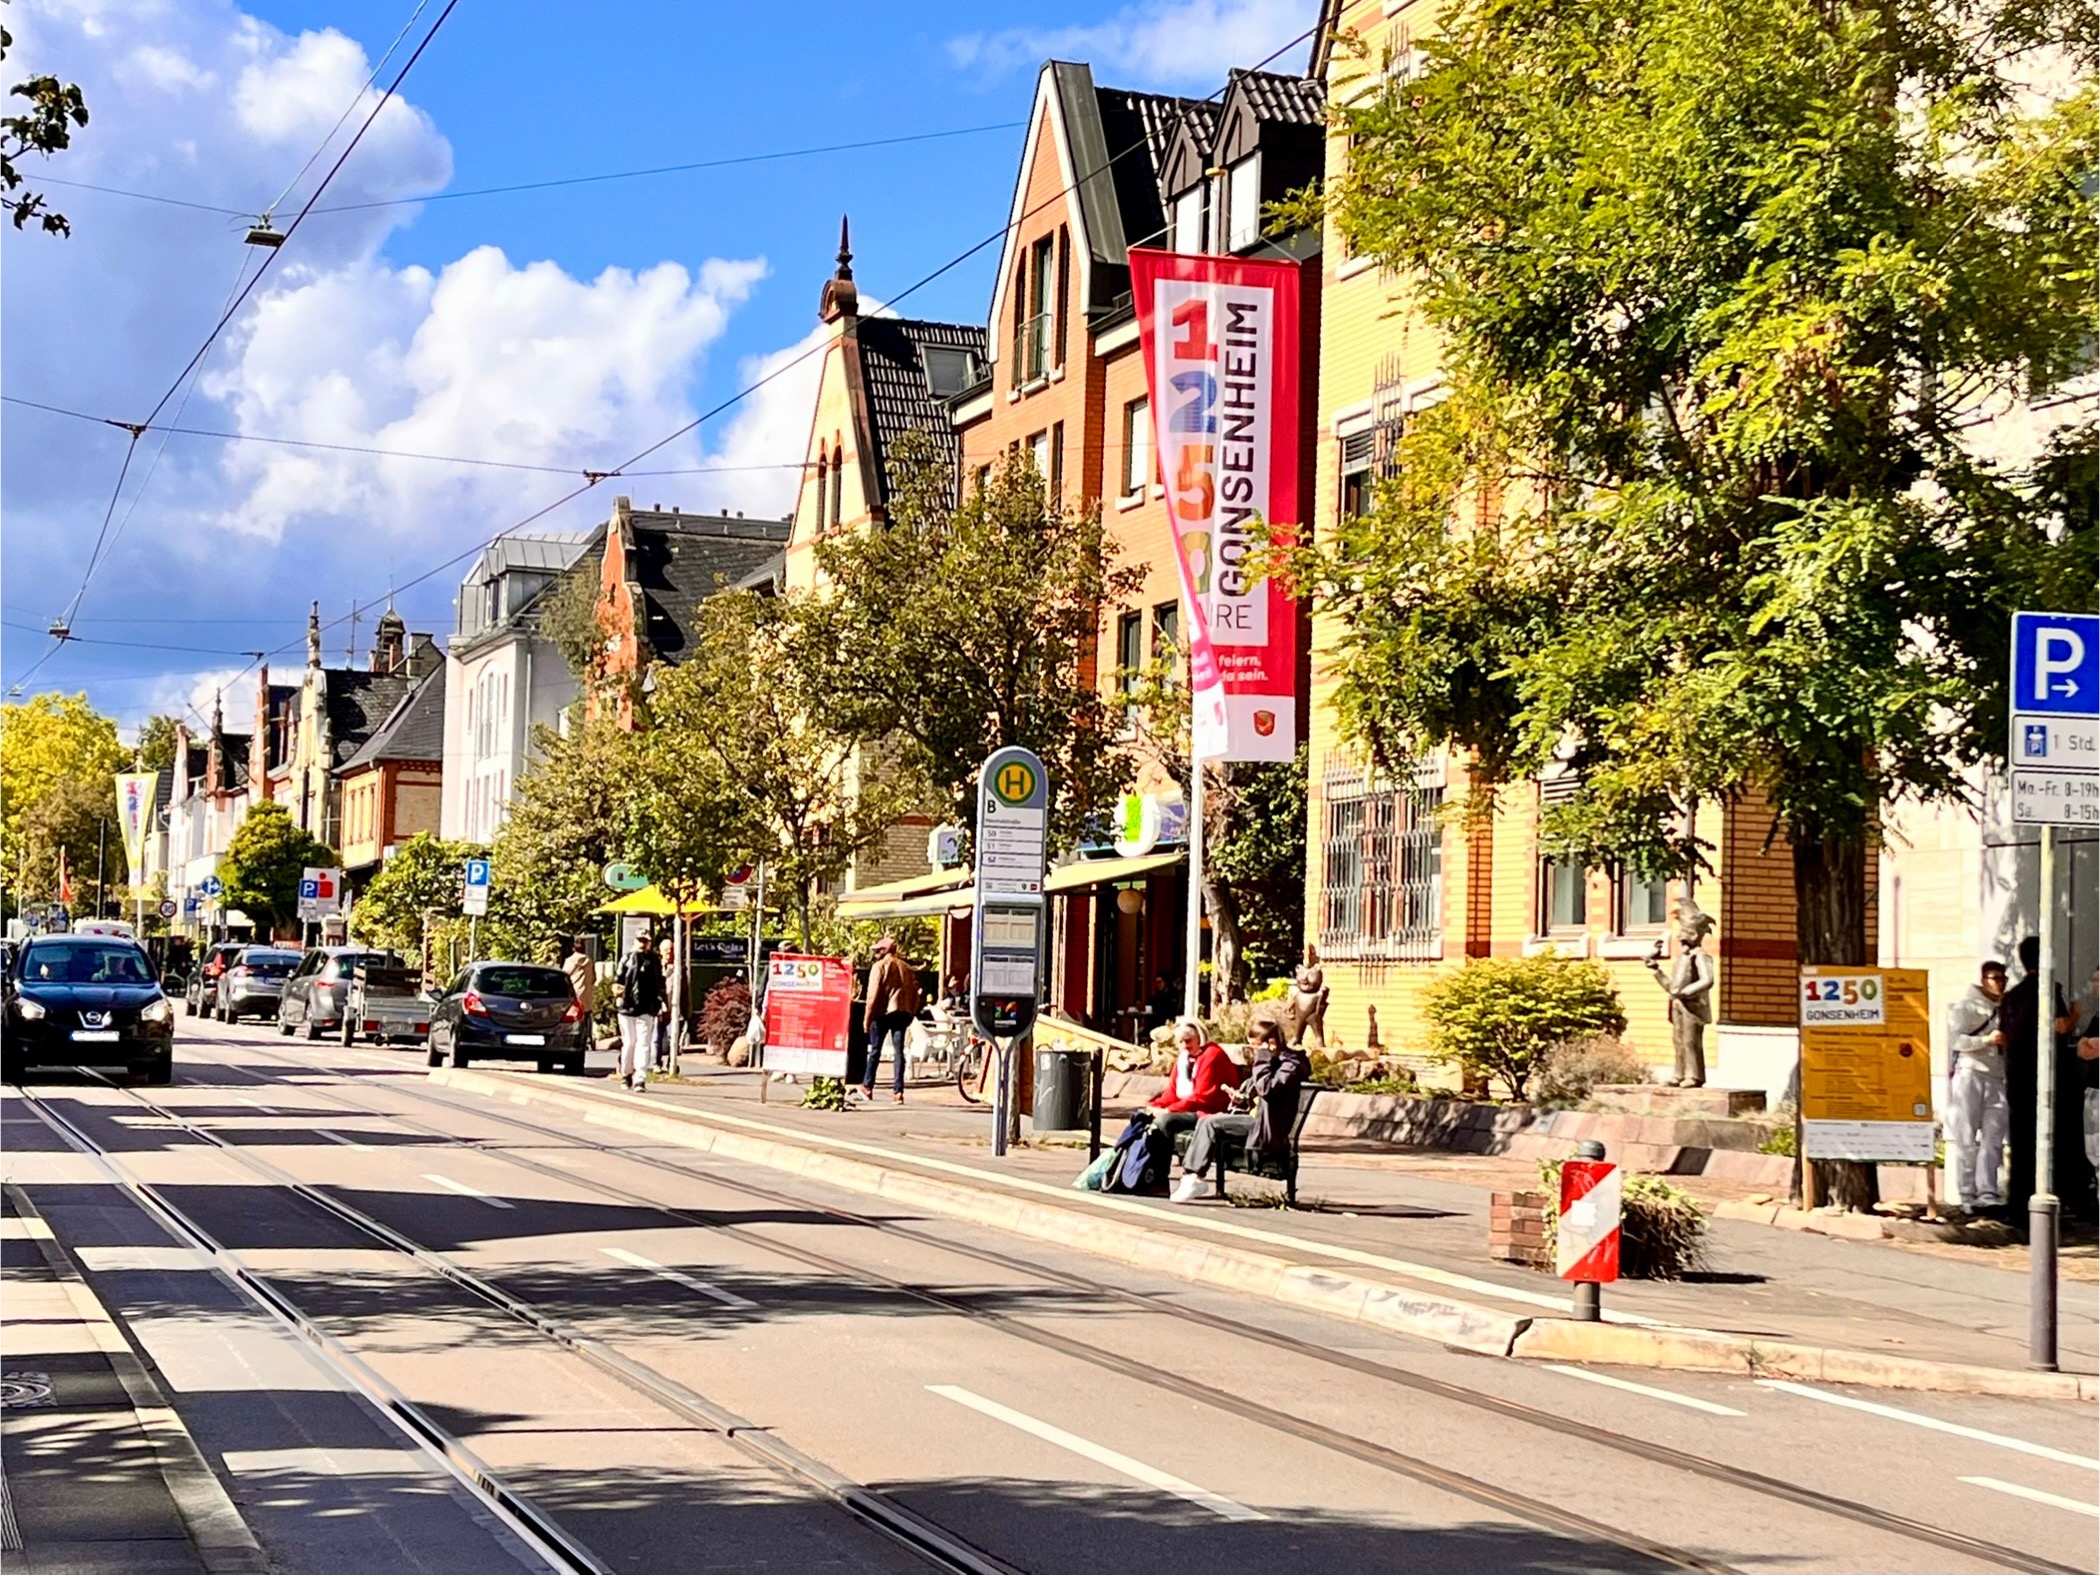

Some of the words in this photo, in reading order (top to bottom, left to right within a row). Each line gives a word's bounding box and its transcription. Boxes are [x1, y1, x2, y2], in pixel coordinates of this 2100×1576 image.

[1217, 302, 1259, 598] GONSENHEIM
[2034, 627, 2085, 700] P
[2052, 734, 2060, 750] 1
[2068, 734, 2097, 752] Std.
[1005, 770, 1025, 795] H
[987, 799, 997, 814] B
[771, 962, 820, 979] 1250
[1804, 978, 1878, 1005] 1250
[1806, 1008, 1880, 1021] GONSENHEIM
